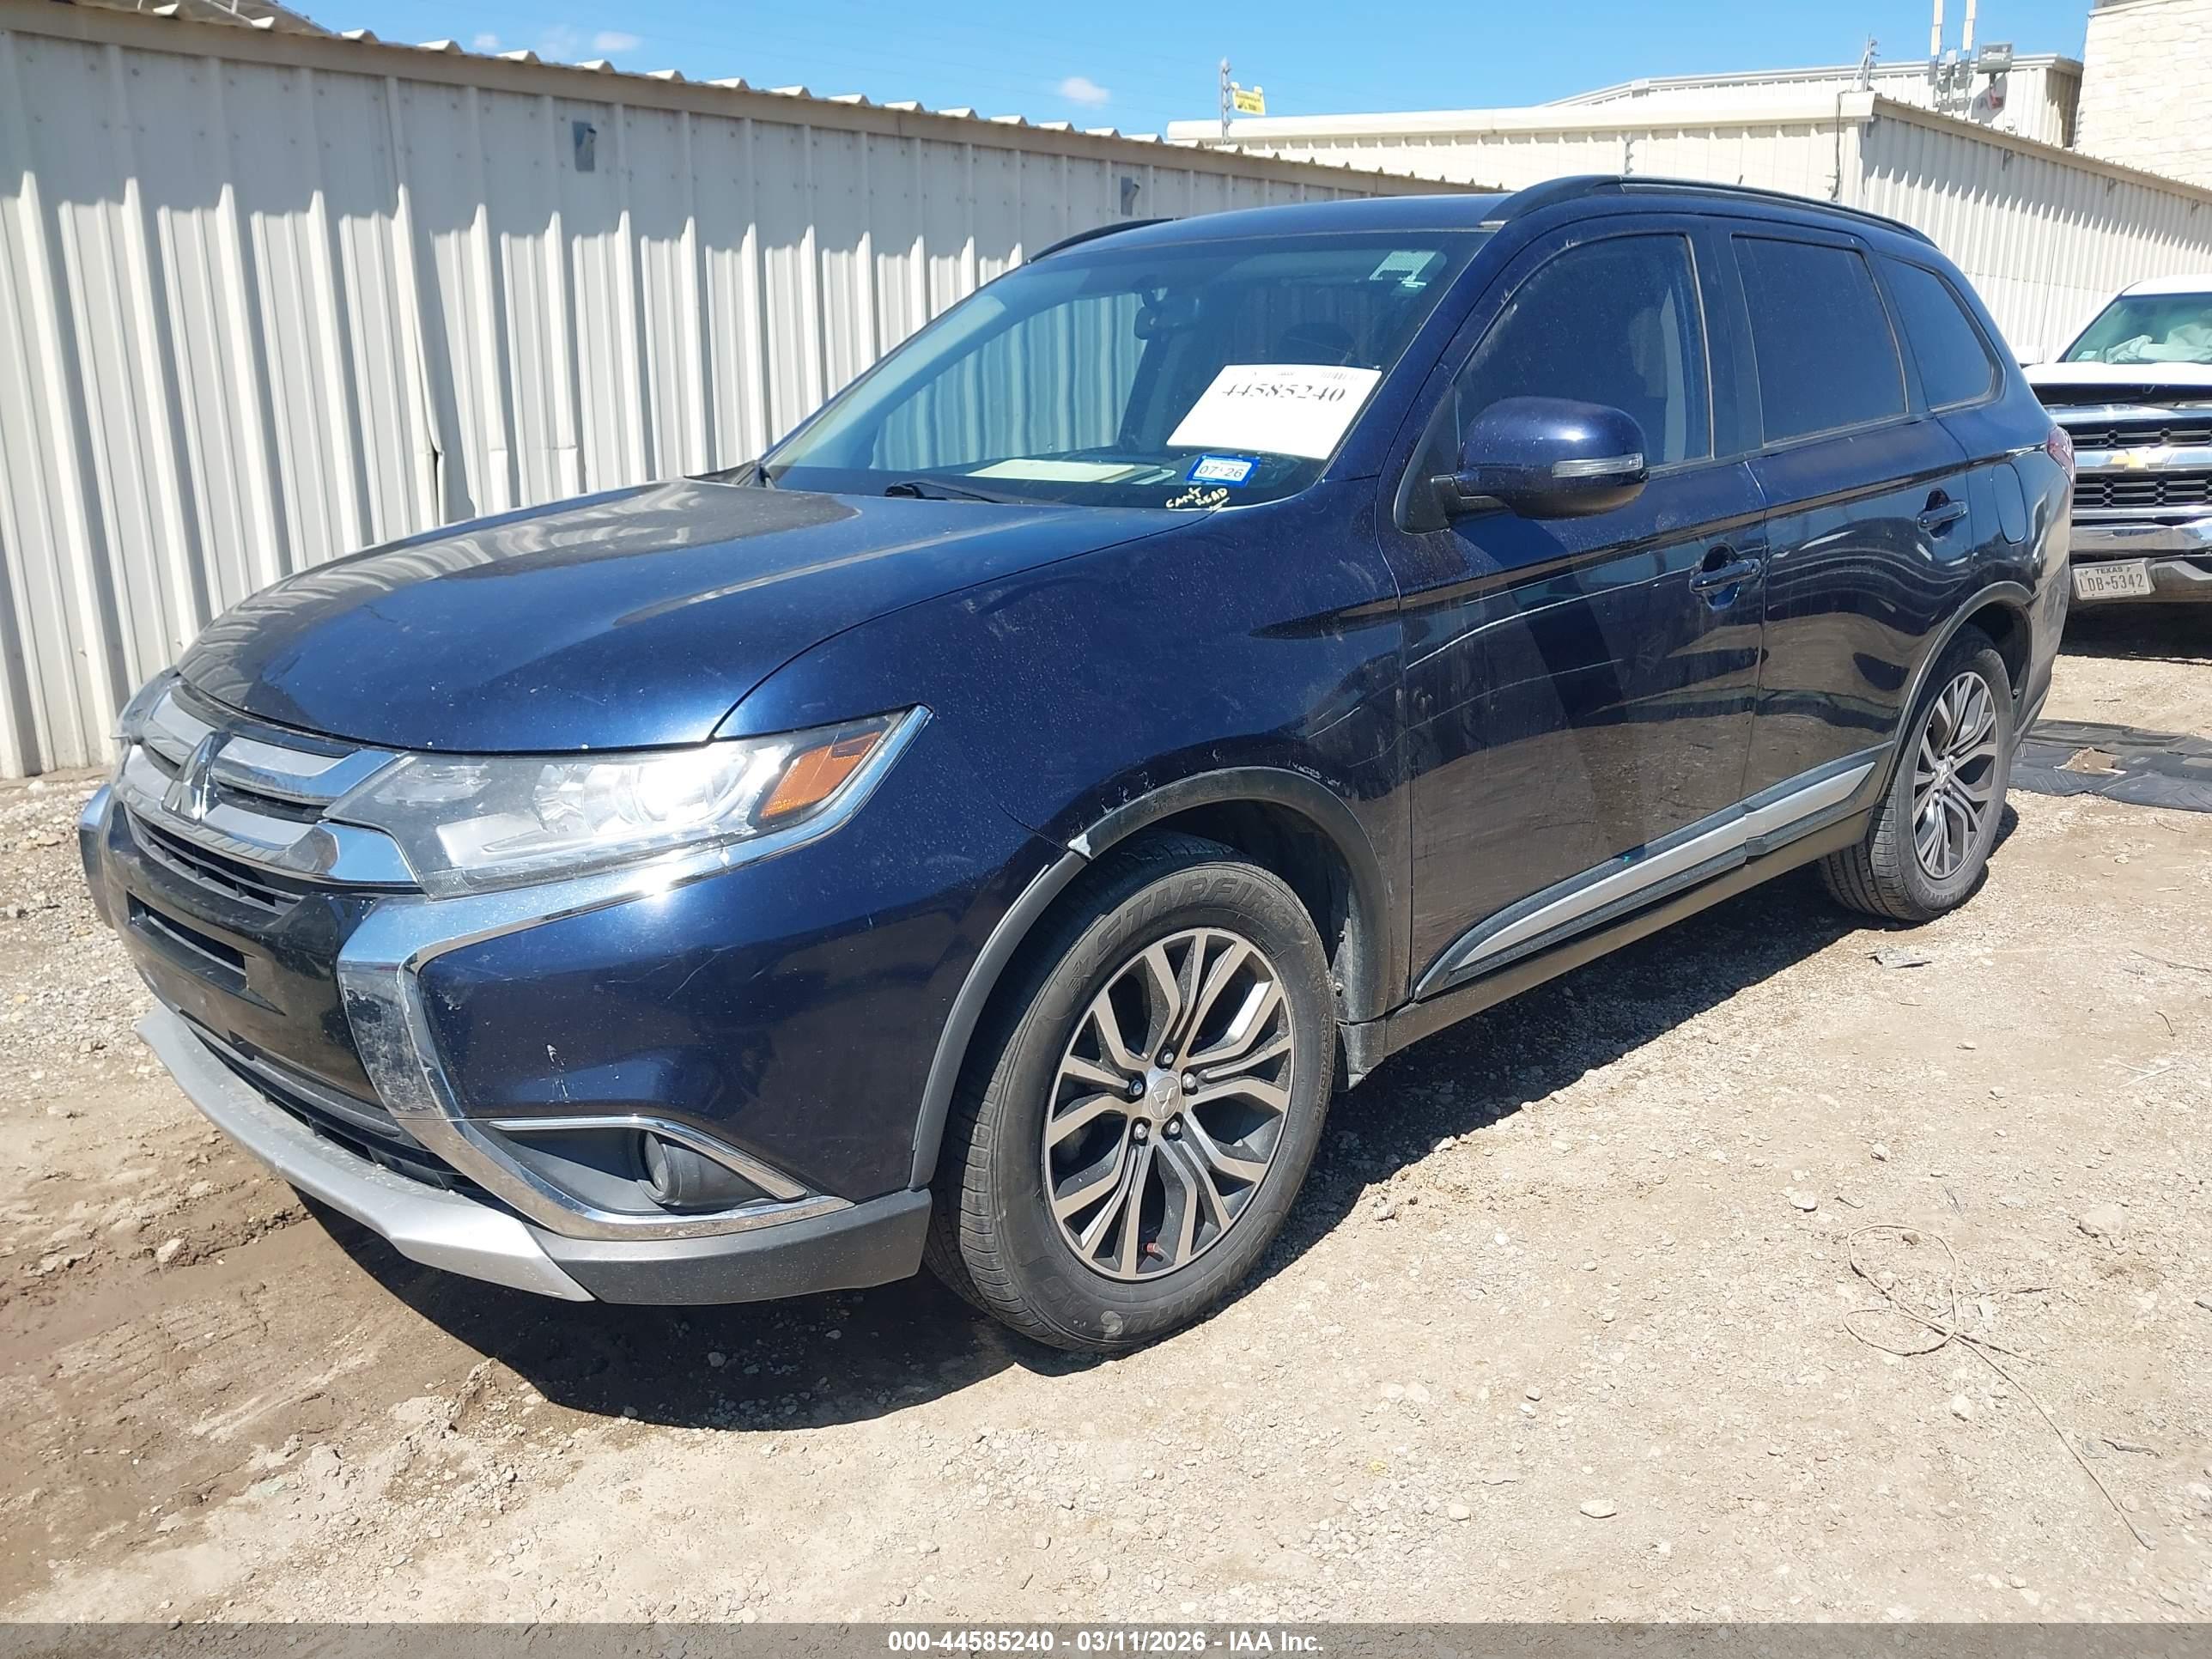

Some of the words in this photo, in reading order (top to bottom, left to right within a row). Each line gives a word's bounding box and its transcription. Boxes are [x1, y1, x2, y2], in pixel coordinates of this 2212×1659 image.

[1222, 383, 1346, 402] 44585240
[1199, 465, 1218, 476] 07
[1224, 467, 1244, 478] 26
[1194, 488, 1228, 507] READ
